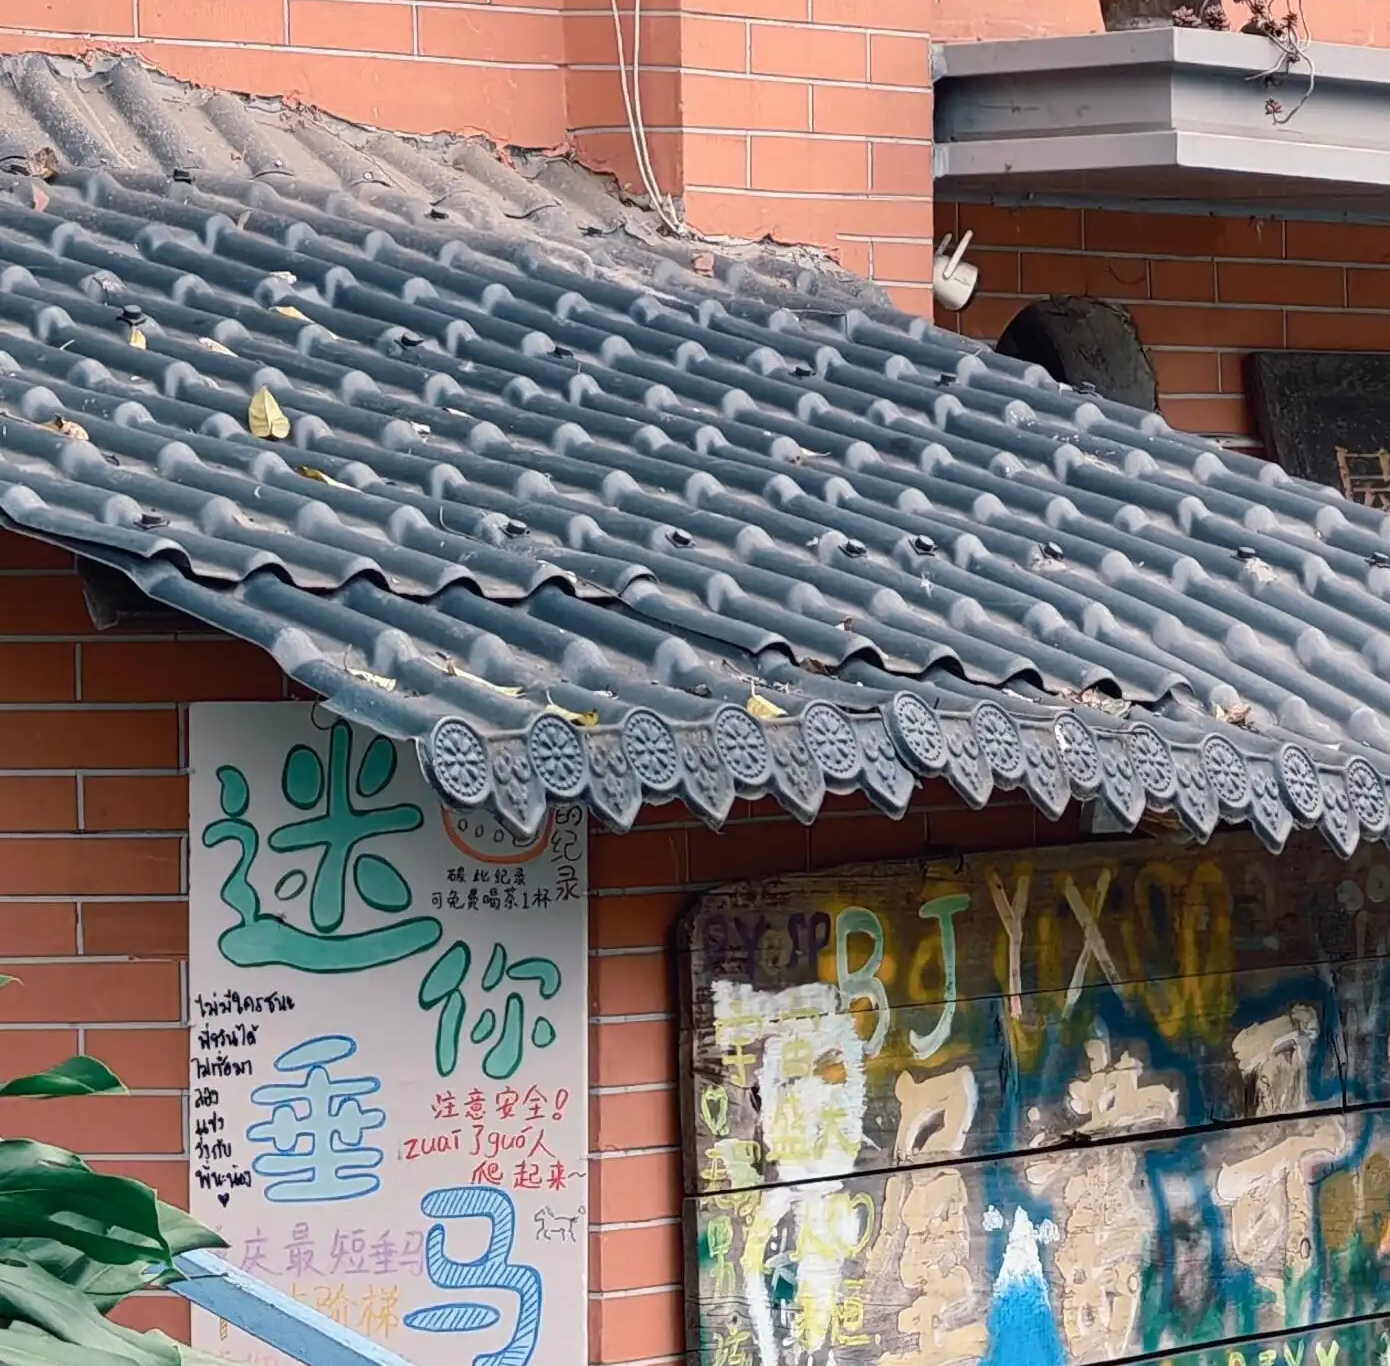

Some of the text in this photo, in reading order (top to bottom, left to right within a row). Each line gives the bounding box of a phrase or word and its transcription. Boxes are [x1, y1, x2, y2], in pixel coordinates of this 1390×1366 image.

[214, 1221, 425, 1278] 庆最短垂马
